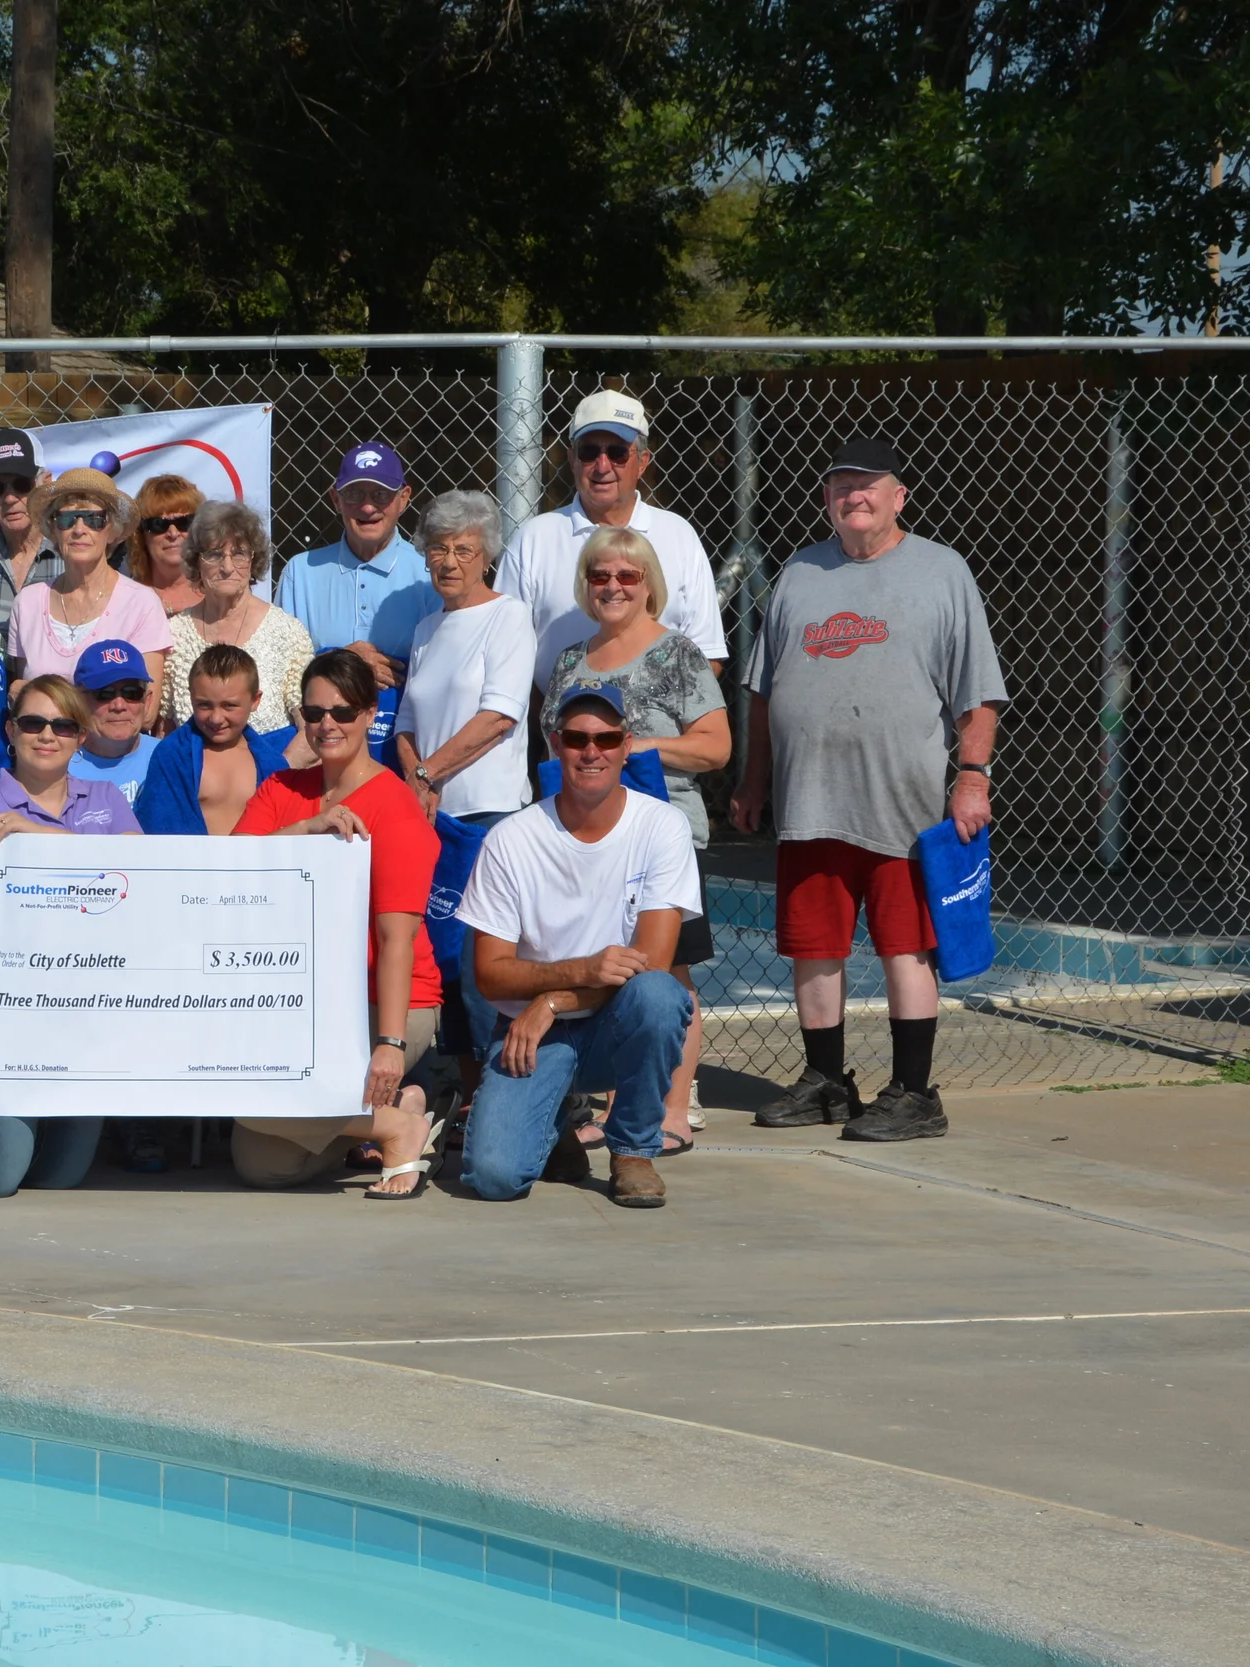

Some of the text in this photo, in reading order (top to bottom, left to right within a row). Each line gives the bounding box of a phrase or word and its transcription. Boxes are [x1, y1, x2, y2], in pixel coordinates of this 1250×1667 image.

[802, 615, 886, 643] Sublette
[101, 648, 129, 664] KU
[6, 883, 117, 896] SouthernPioneer
[46, 896, 115, 904] ELECTRIC COMPANY
[181, 894, 268, 906] Date: April 18, 2014
[62, 903, 79, 911] Utility
[8, 951, 16, 959] to
[16, 951, 25, 960] the
[210, 949, 300, 970] $ 3,500.00
[18, 960, 25, 968] of
[29, 953, 126, 971] City of Sublette
[36, 993, 96, 1008] Thousand
[98, 993, 123, 1008] Five
[125, 994, 180, 1008] Hundred
[183, 994, 227, 1008] Dollars
[230, 994, 255, 1008] and
[257, 994, 303, 1009] 00/100
[4, 1063, 68, 1072] For: H.U.G.S. Donation
[187, 1064, 290, 1073] Southern Pioneer Electric Company
